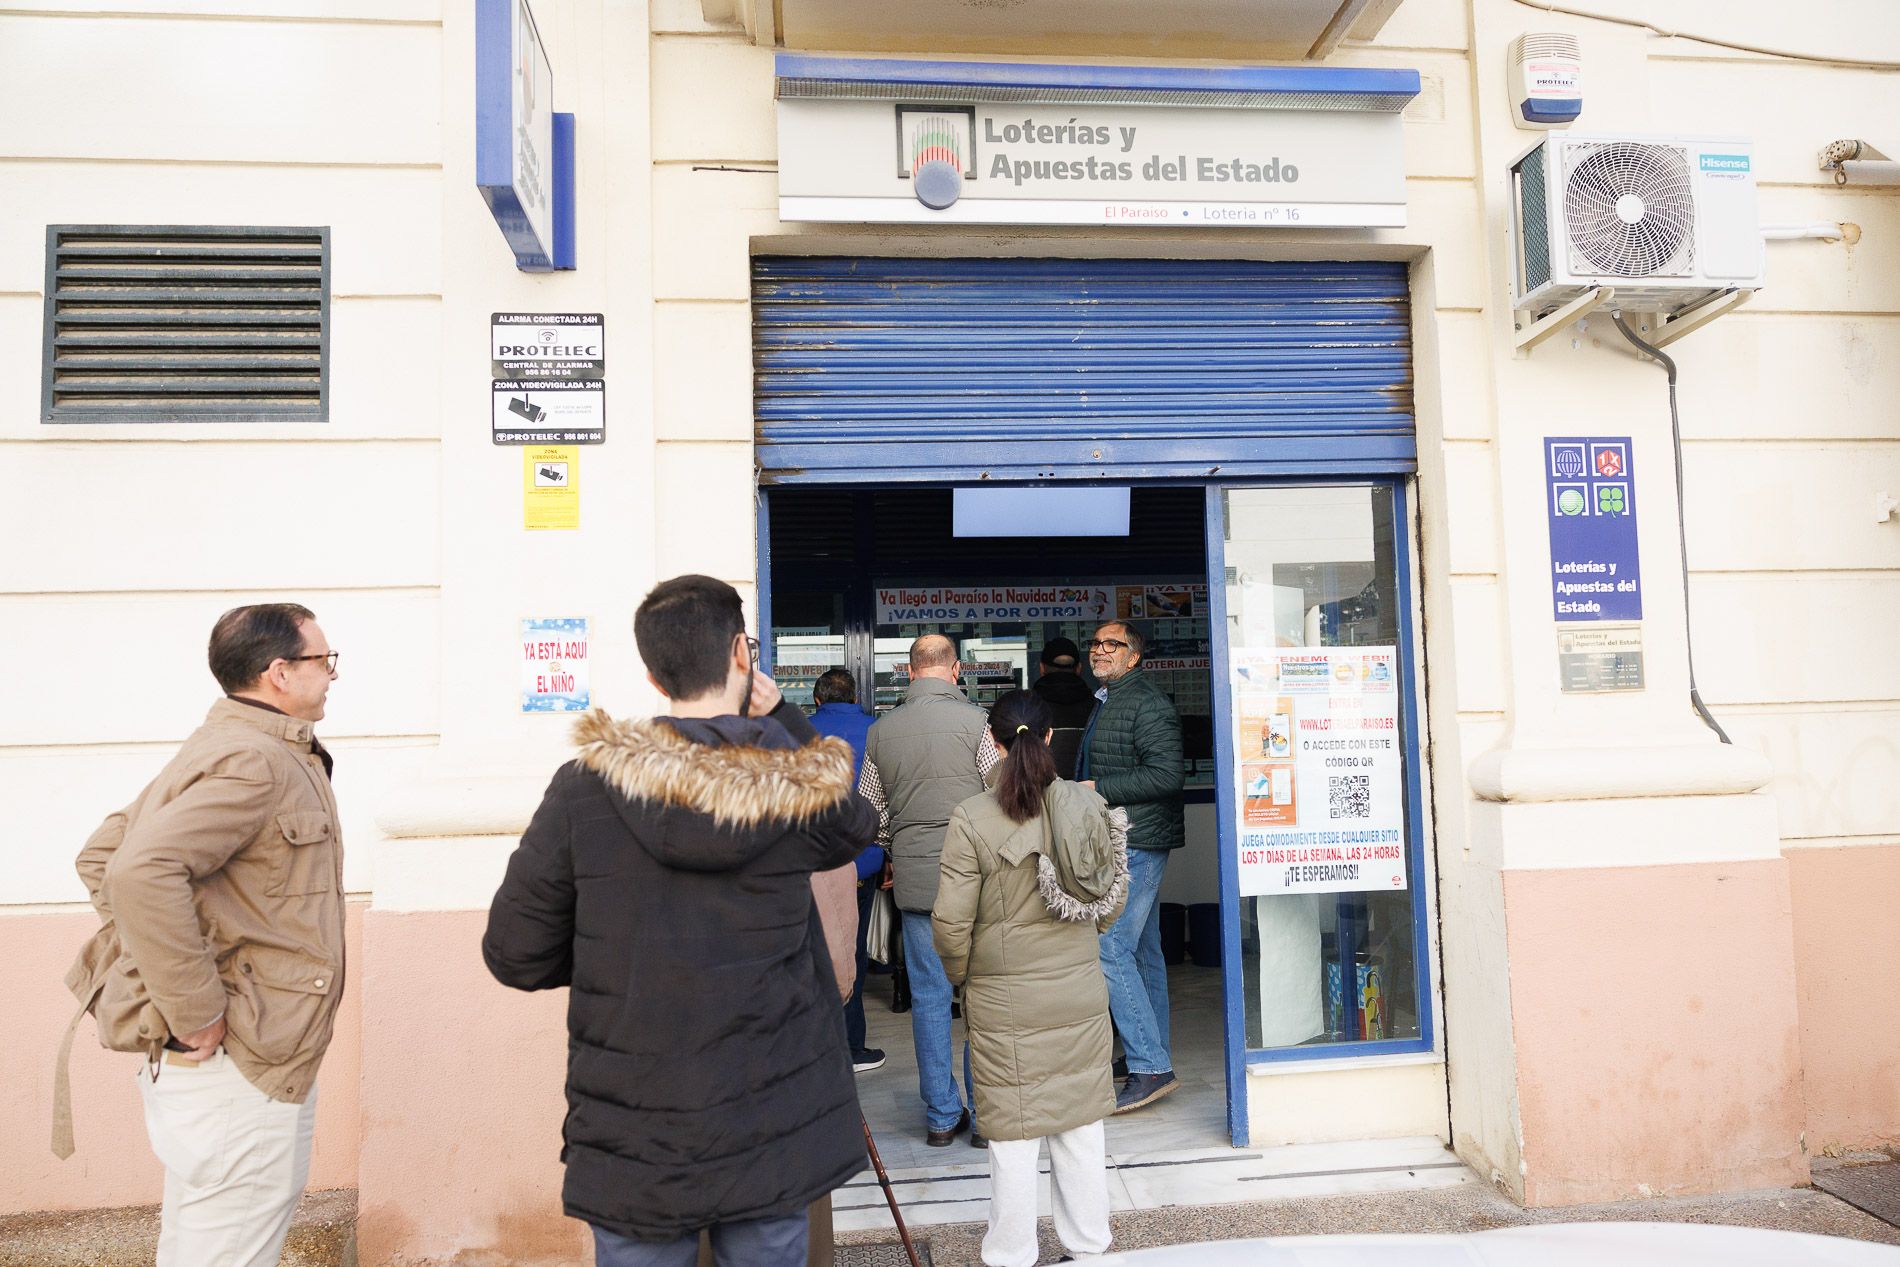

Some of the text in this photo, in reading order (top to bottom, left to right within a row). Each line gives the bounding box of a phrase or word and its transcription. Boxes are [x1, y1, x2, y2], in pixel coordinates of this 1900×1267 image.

[984, 117, 1137, 153] Loterías y
[989, 153, 1300, 186] Apuestas del Estado
[1701, 157, 1749, 169] Hisense
[1105, 206, 1117, 218] El
[1285, 207, 1300, 221] 16
[499, 315, 598, 323] ALARMA CONECTADA 24H
[499, 345, 597, 356] PROTELEC
[494, 381, 602, 389] ZONA VIDEOVIGILADA 24H
[506, 433, 561, 441] PROTELEC
[1555, 560, 1617, 576] Loterías y
[1556, 579, 1637, 596] Apuestas del
[880, 590, 896, 605] Ya
[899, 589, 928, 607] llegó
[930, 589, 942, 605] al
[945, 588, 989, 604] Paraíso
[992, 588, 1003, 603] la
[1006, 587, 1056, 603] Navidad
[889, 606, 1082, 622] ¡VAMOS A POR OTRO!
[1557, 599, 1601, 613] Estado
[524, 642, 535, 660] YA
[537, 671, 575, 693] EL NIÑO
[1303, 738, 1391, 751] O ACCEDE CON ESTE
[1361, 757, 1374, 767] QR
[1241, 833, 1264, 848] JUEGA
[1318, 831, 1340, 845] DESDE
[1341, 829, 1380, 844] CUALQUIER
[1381, 829, 1399, 843] SITIO
[1242, 850, 1258, 865] LOS
[1259, 850, 1265, 864] 7
[1286, 849, 1297, 863] DE
[1298, 848, 1309, 863] LA
[1310, 847, 1345, 864] SEMANA,
[1345, 846, 1361, 861] LAS
[1362, 846, 1373, 860] 24
[1374, 845, 1400, 860] HORAS
[1302, 863, 1359, 882] ESPERAMOS!!
